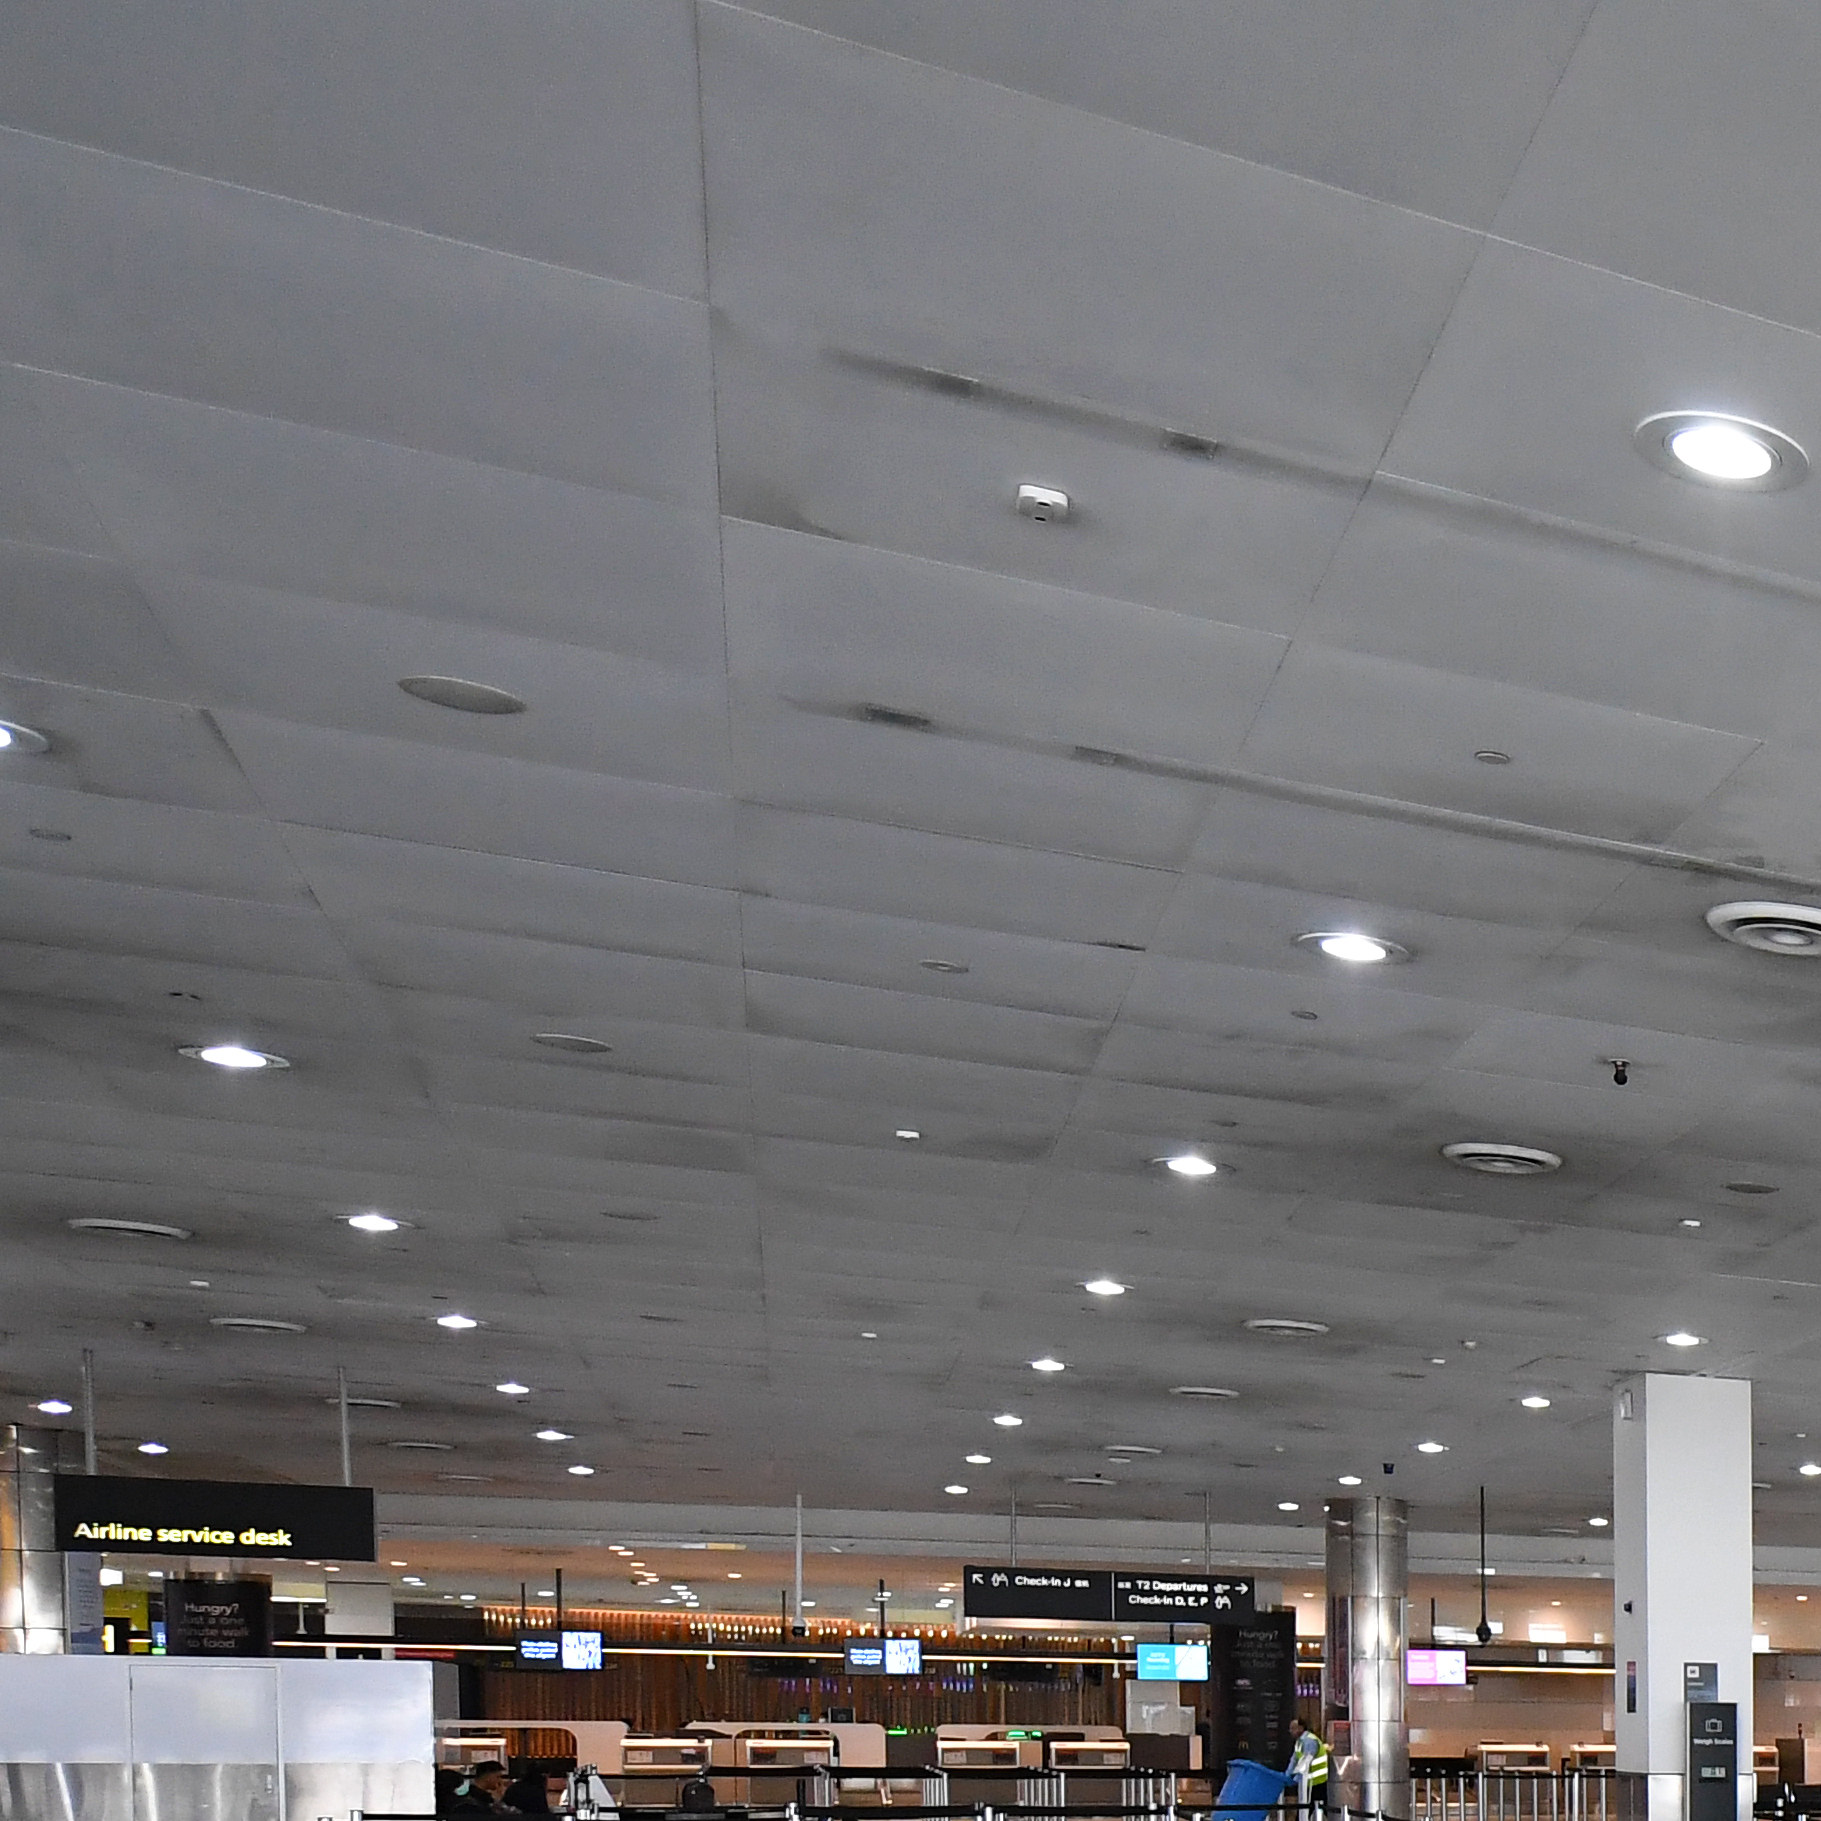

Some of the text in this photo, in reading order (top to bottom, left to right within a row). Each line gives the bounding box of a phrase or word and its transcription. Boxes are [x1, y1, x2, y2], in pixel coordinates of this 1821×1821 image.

[74, 1522, 292, 1546] Airline service desk
[1015, 1576, 1061, 1587] Check-in
[1136, 1580, 1149, 1590] T2
[1153, 1581, 1208, 1593] Departures
[1129, 1595, 1173, 1606] Check-in
[184, 1602, 239, 1616] Hungry?
